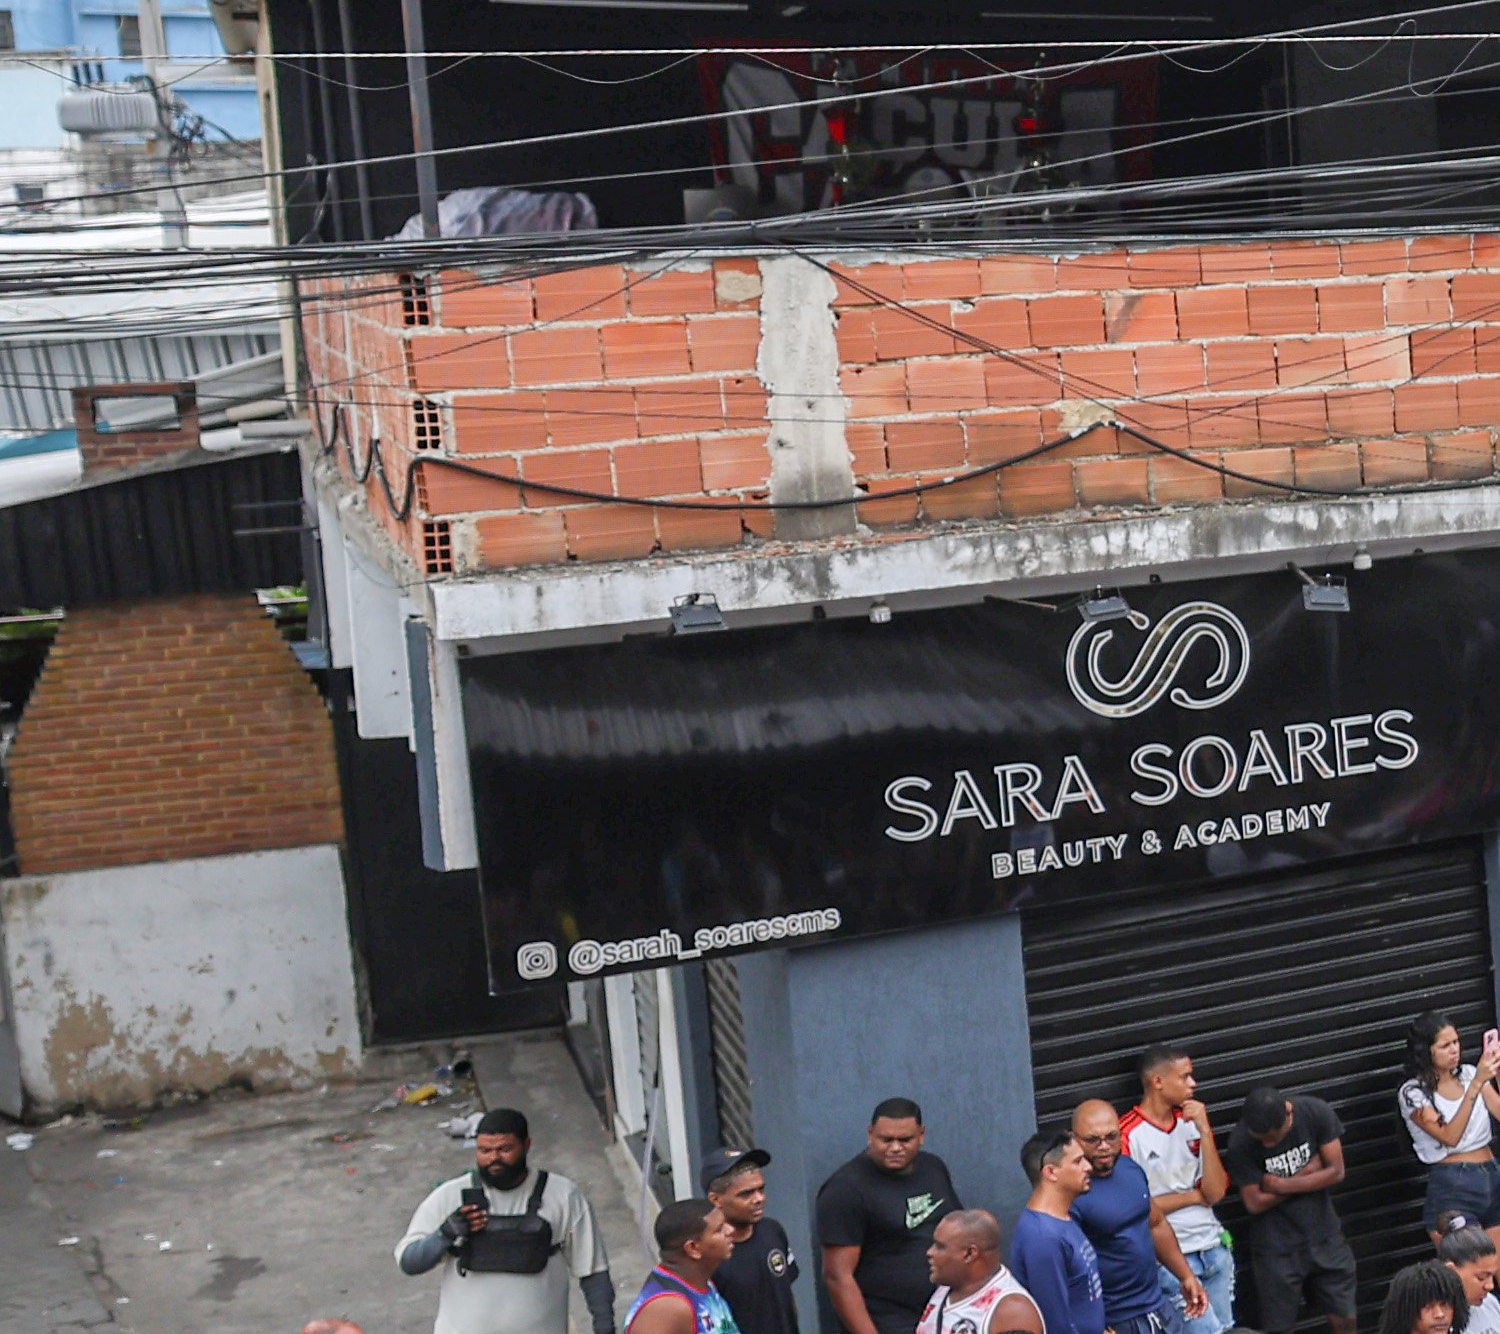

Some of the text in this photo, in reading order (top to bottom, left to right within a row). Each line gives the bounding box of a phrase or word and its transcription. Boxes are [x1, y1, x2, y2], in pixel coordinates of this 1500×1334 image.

[885, 710, 1419, 842] SARA SOARES
[992, 802, 1331, 878] BEAUTY & ACADEMY
[569, 908, 841, 975] @sarah_soarescms
